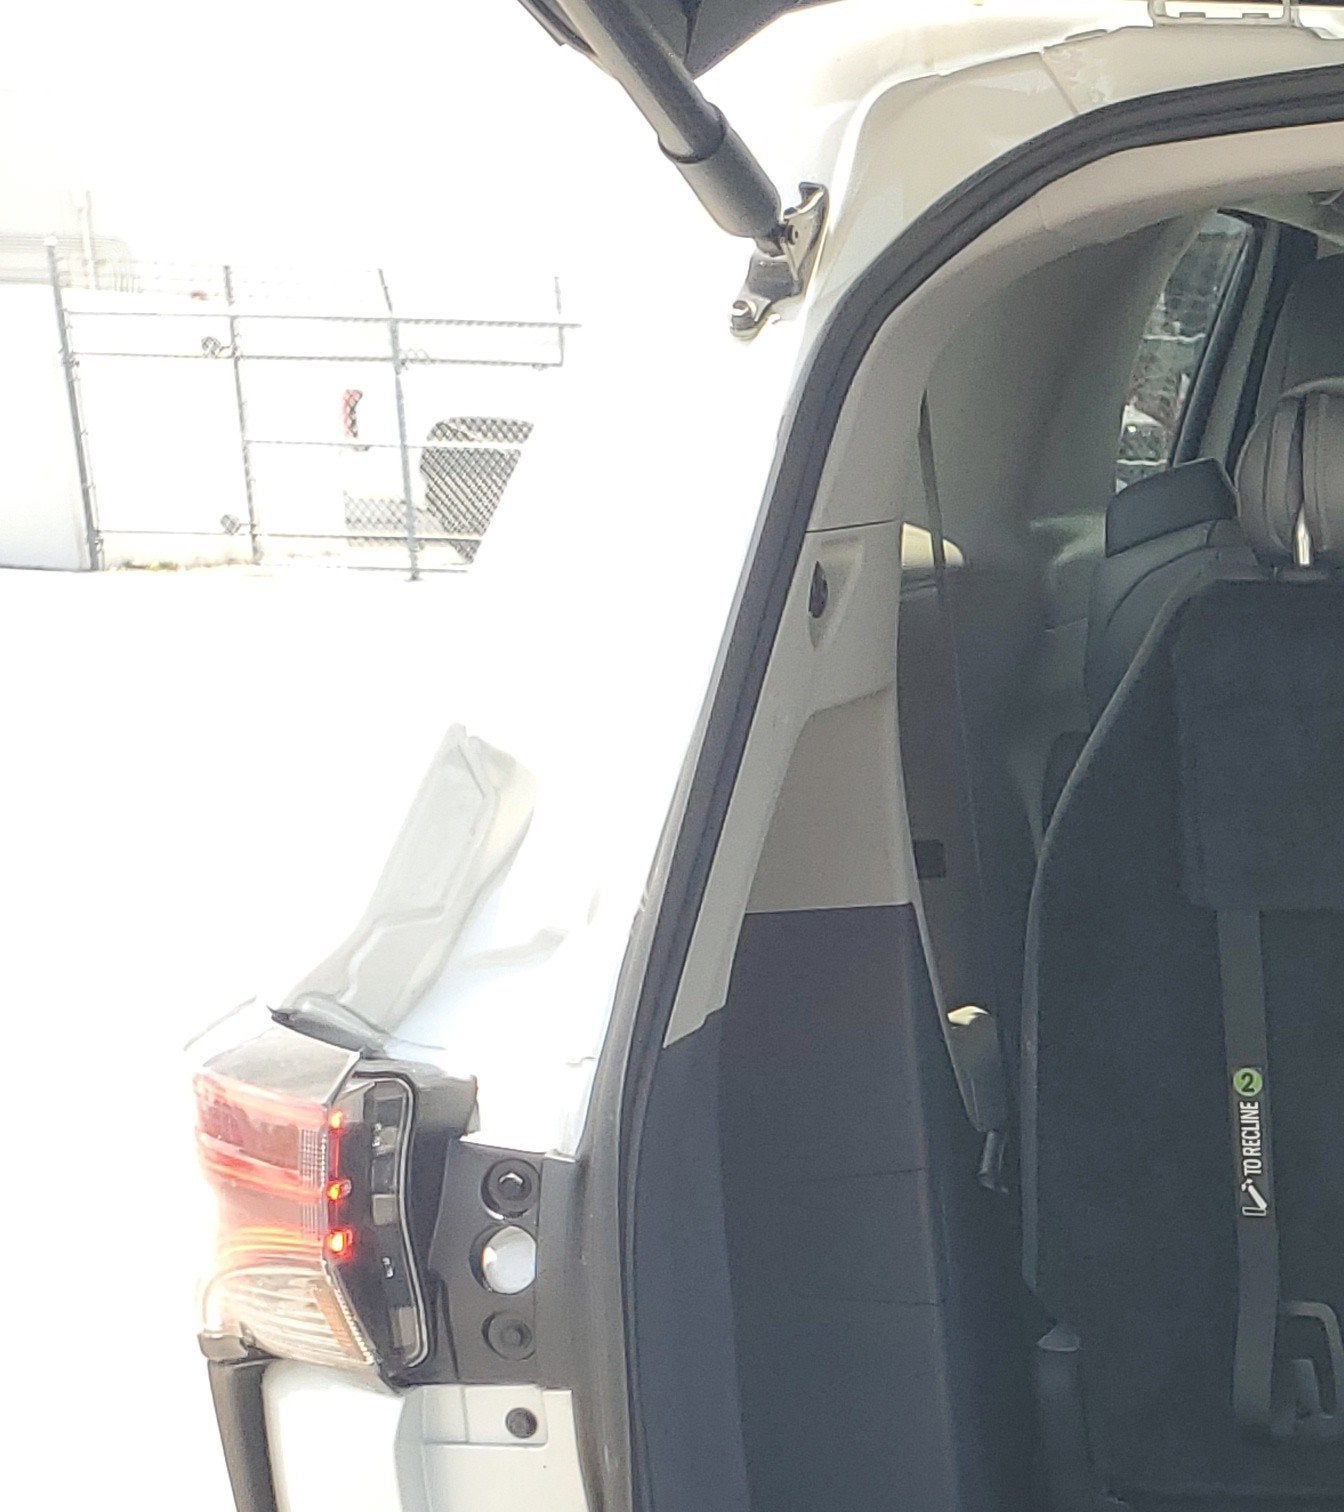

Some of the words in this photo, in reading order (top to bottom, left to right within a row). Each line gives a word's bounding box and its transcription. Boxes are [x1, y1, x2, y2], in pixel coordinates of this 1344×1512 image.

[1241, 1072, 1256, 1093] 2
[1240, 1101, 1262, 1157] RECLINE
[1243, 1159, 1262, 1176] TO
